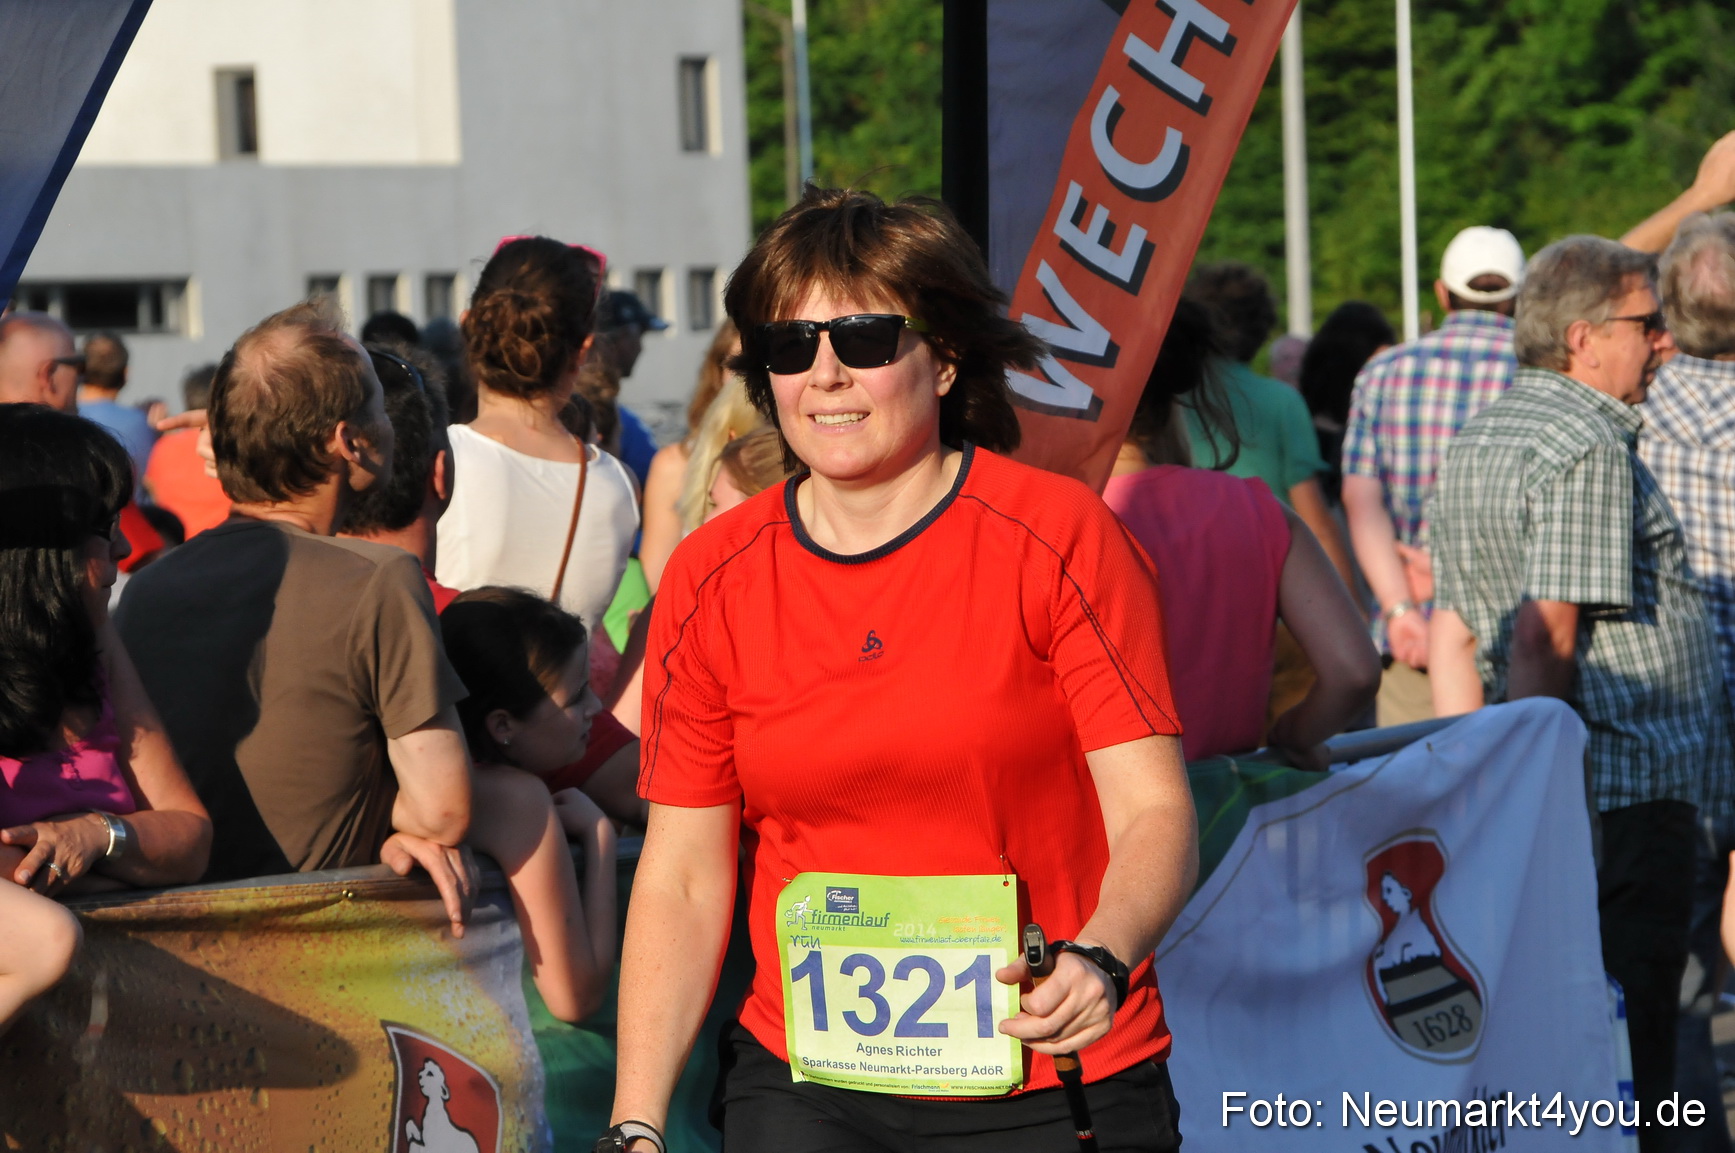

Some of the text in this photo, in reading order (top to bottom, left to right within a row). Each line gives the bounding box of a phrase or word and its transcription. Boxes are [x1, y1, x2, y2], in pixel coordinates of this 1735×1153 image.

[811, 909, 890, 928] firmenlauf
[893, 923, 937, 937] 2014
[791, 950, 994, 1038] 1321
[1412, 1004, 1473, 1048] 1628
[856, 1042, 943, 1057] Agnes Richter
[802, 1056, 1004, 1077] Sparkasse Neumarkt-Parsberg AdöR
